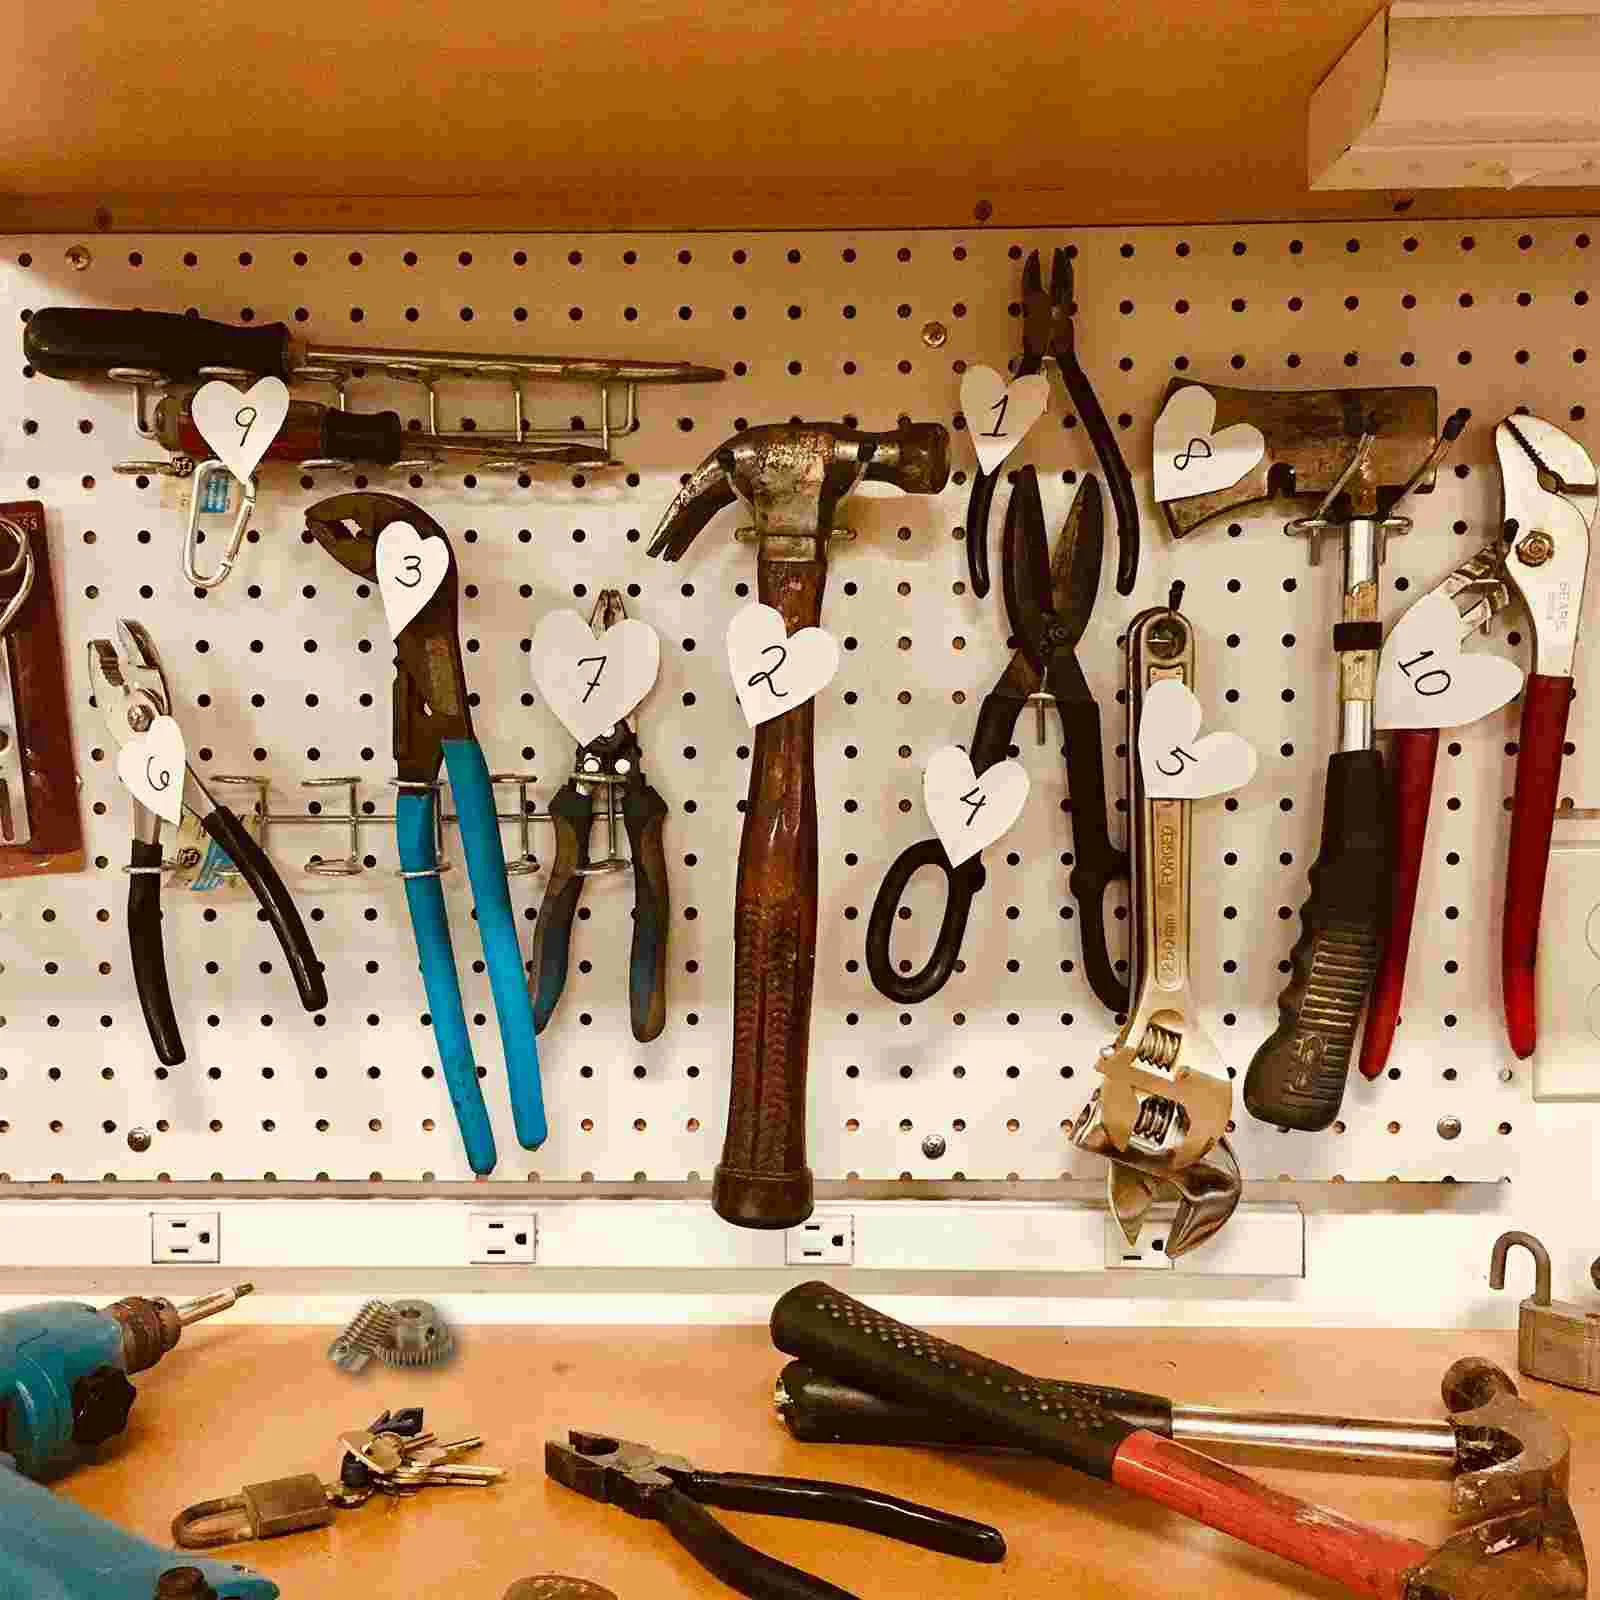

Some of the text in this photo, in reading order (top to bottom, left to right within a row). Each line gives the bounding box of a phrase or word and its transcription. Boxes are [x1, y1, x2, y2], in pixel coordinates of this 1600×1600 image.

[227, 406, 257, 447] 9
[980, 394, 1009, 438] 1
[1174, 436, 1213, 471] 8
[395, 555, 422, 588] 3
[577, 655, 607, 703] 7
[748, 645, 789, 697] 2
[1397, 650, 1451, 697] 10
[147, 756, 170, 792] 6
[1156, 746, 1198, 777] 5
[960, 786, 986, 827] 4
[1160, 823, 1177, 888] FORGED
